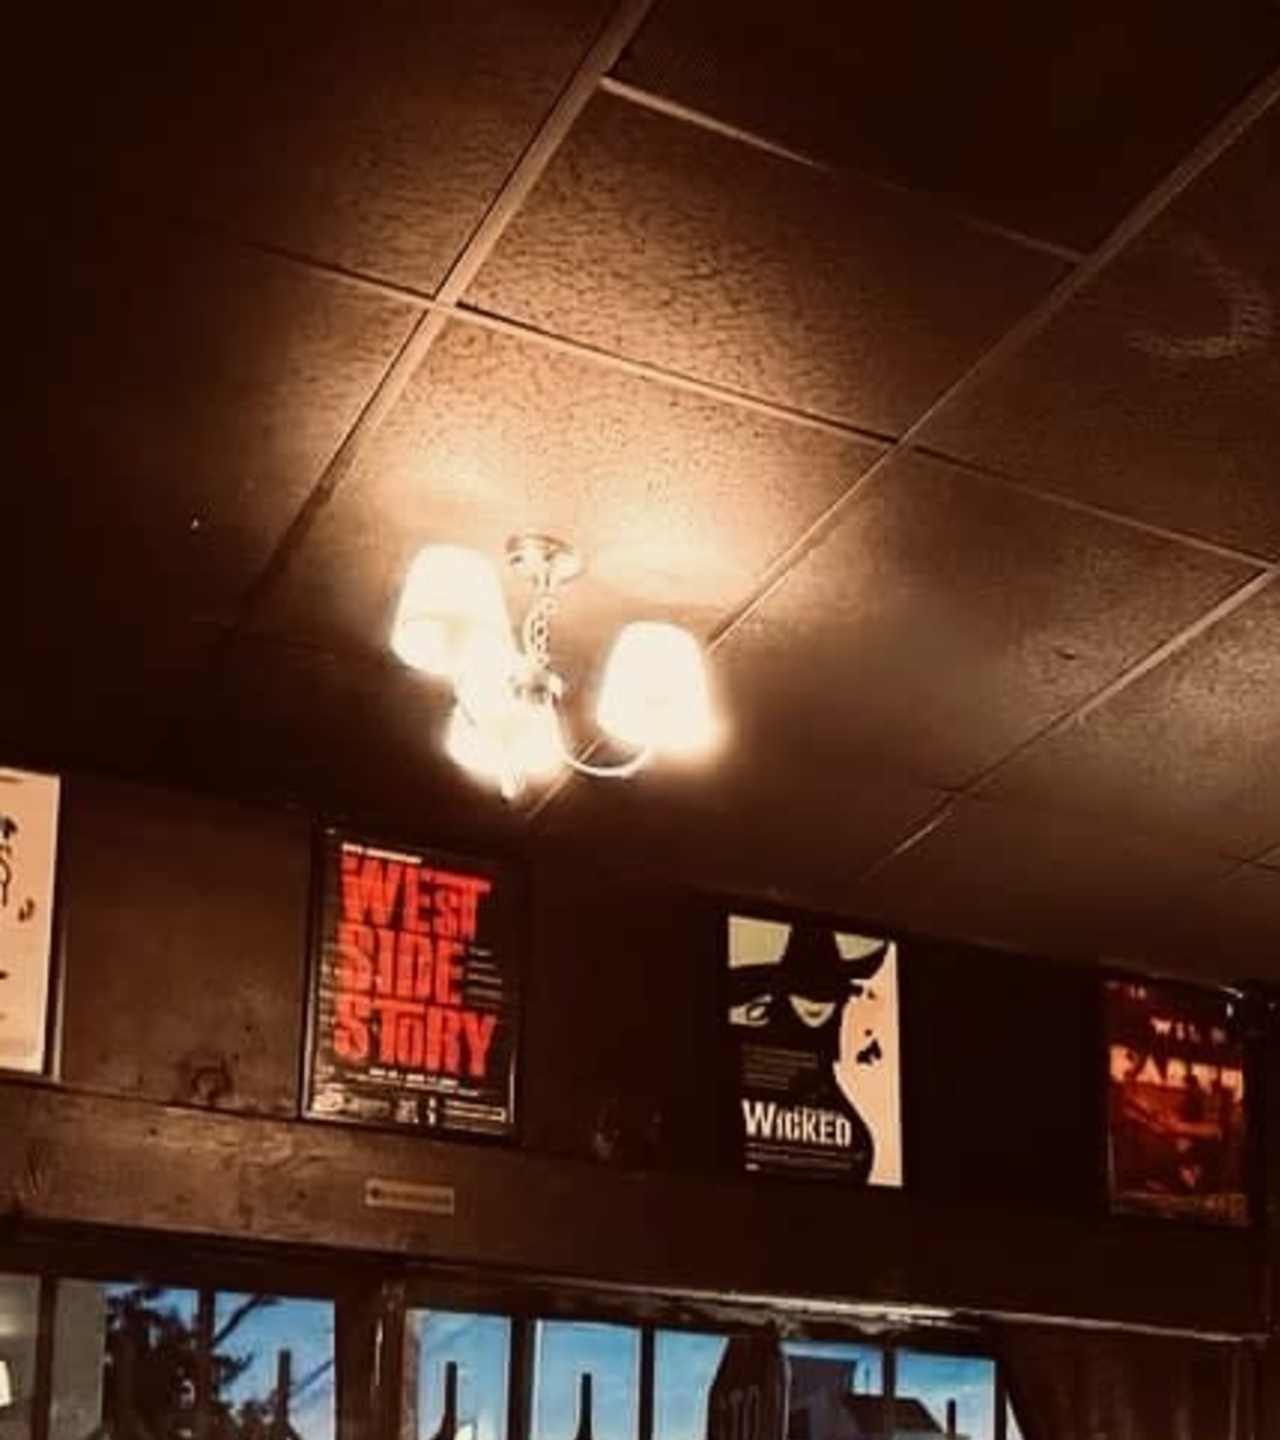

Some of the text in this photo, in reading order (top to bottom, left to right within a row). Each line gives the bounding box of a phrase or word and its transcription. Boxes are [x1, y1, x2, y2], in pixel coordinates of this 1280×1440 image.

[340, 855, 491, 941] WEST
[336, 924, 466, 1006] SIDE
[333, 994, 497, 1077] STORY
[1109, 1041, 1245, 1103] PARTY
[741, 1097, 853, 1148] WICKED
